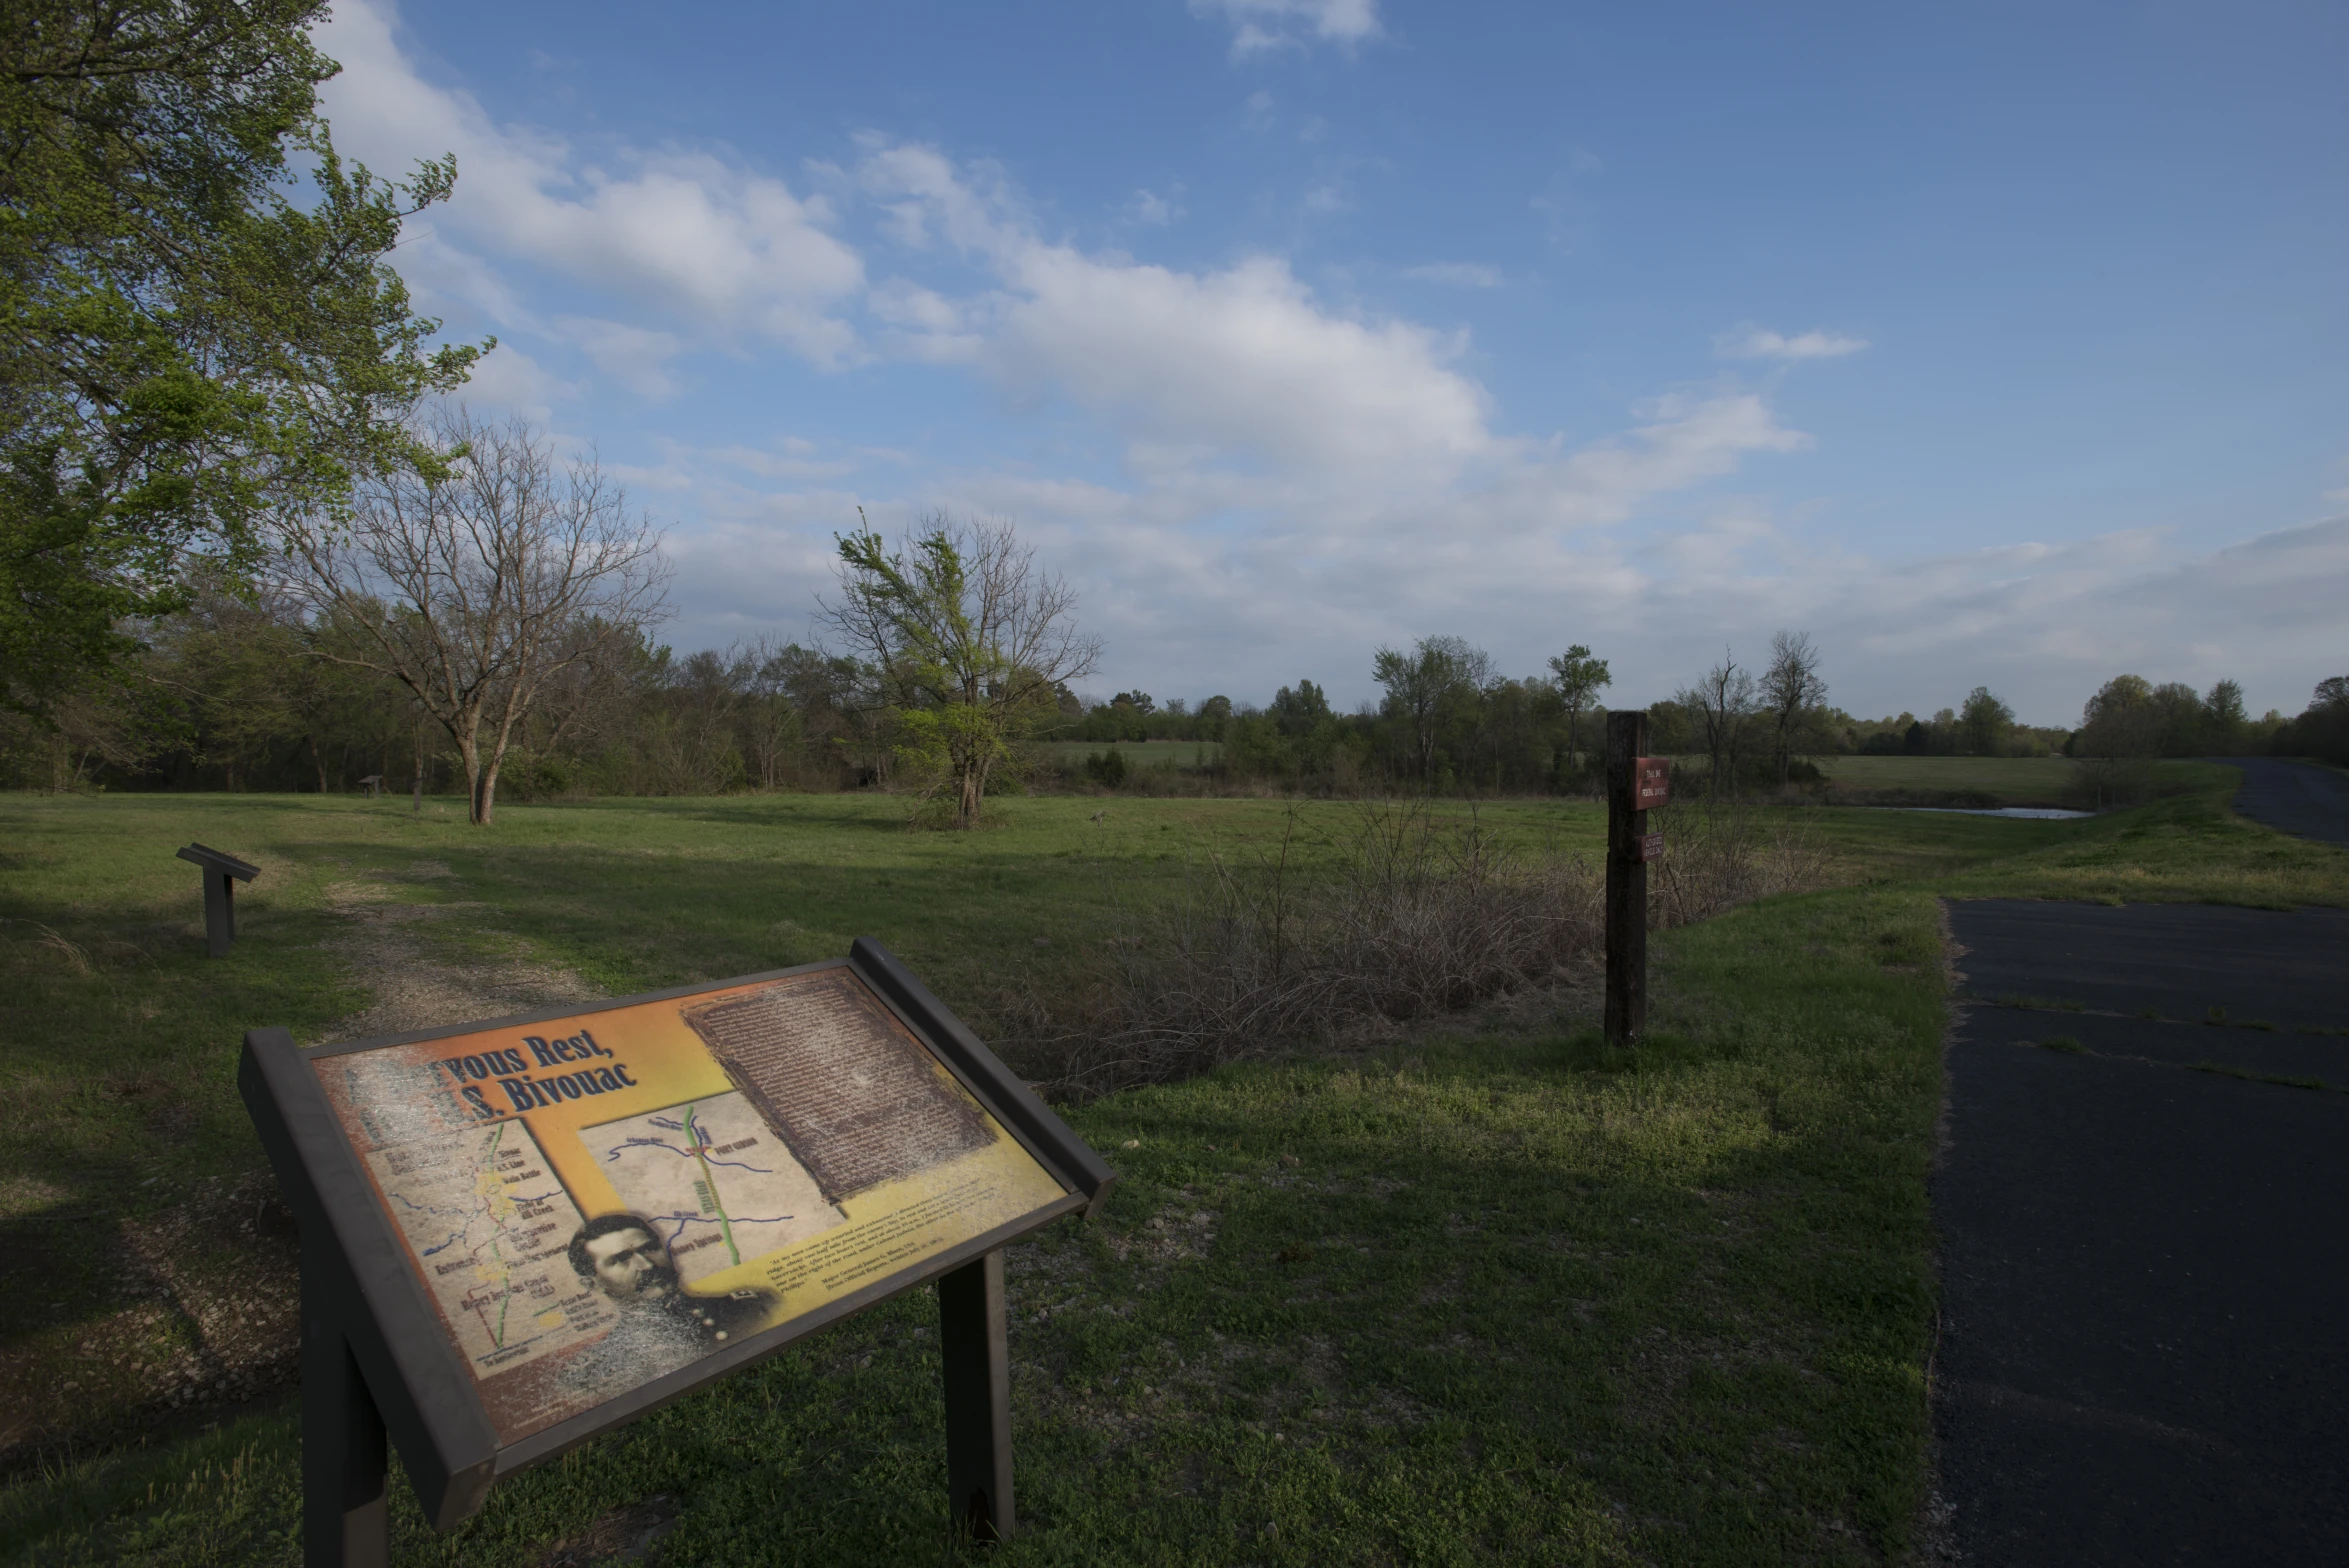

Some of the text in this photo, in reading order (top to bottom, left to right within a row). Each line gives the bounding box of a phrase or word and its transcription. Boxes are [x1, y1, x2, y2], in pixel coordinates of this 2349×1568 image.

[522, 1030, 614, 1067] Rest,
[497, 1063, 637, 1112] Bivouac
[693, 1233, 722, 1248] Springs
[842, 1236, 856, 1245] from
[808, 1264, 823, 1273] right
[821, 1274, 839, 1284] Major
[839, 1263, 863, 1275] General
[862, 1257, 880, 1267] James
[844, 1270, 866, 1282] Official
[889, 1252, 909, 1262] written
[908, 1247, 920, 1255] July
